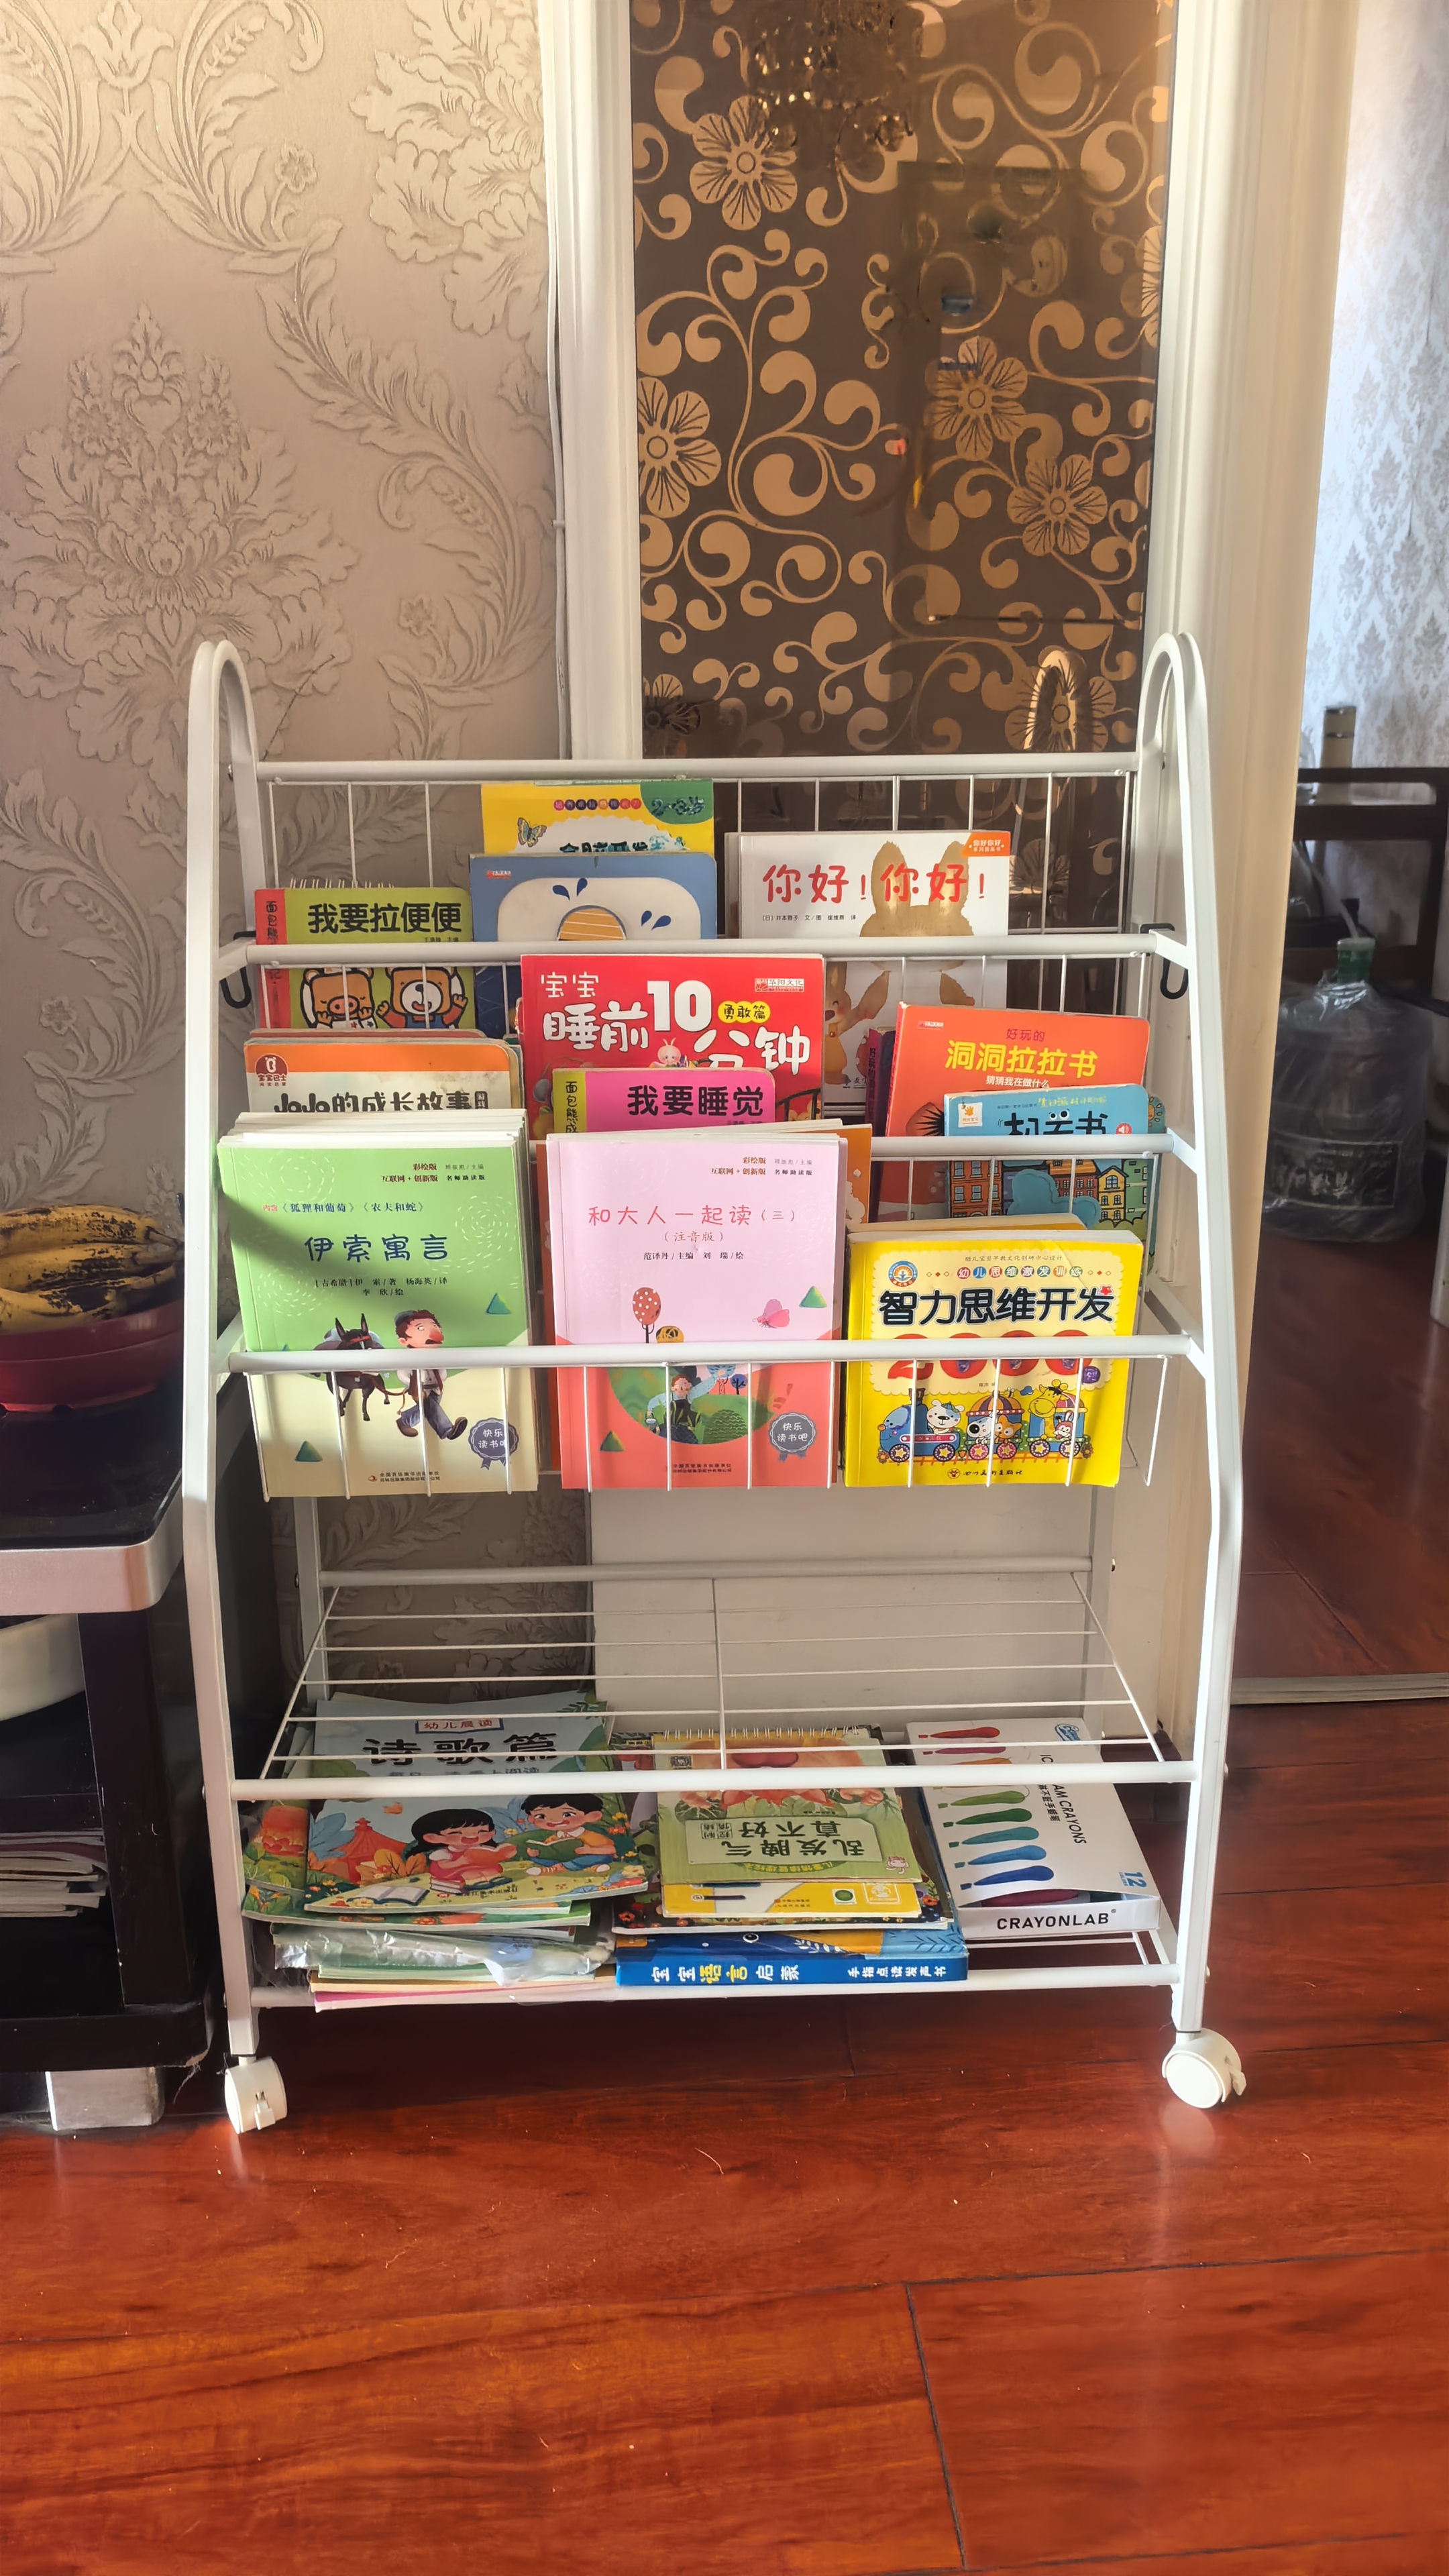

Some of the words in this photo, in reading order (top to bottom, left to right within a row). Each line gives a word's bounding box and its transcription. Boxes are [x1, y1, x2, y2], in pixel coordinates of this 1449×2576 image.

[307, 902, 462, 933] 我要拉便便
[723, 1004, 767, 1020] 勇敢篇
[1006, 1028, 1045, 1042] 好玩的
[945, 1040, 1098, 1079] 洞洞拉拉书
[258, 1074, 287, 1082] 宝宝巴士
[985, 1075, 1050, 1089] 猜猜我在做什么
[627, 1085, 764, 1117] 我要睡觉
[413, 1163, 437, 1171] 彩绘版
[742, 1156, 767, 1165] 彩绘版
[304, 1234, 448, 1263] 伊索寓言
[877, 1287, 1116, 1326] 智力思维开发
[482, 1428, 504, 1438] 快乐
[782, 1421, 803, 1432] 快乐
[777, 1433, 808, 1442] 读书吧
[362, 1732, 557, 1766] 诗歌篇
[739, 1820, 841, 1837] 真不好
[1059, 1800, 1087, 1844] CRAYONS
[721, 1839, 865, 1857] 乱发脾气
[1124, 1872, 1147, 1888] 12
[996, 1913, 1110, 1931] CRAYONLAB
[651, 1963, 800, 1985] 宝宝语言启蒙
[847, 1966, 947, 1979] 手指点读发声书
